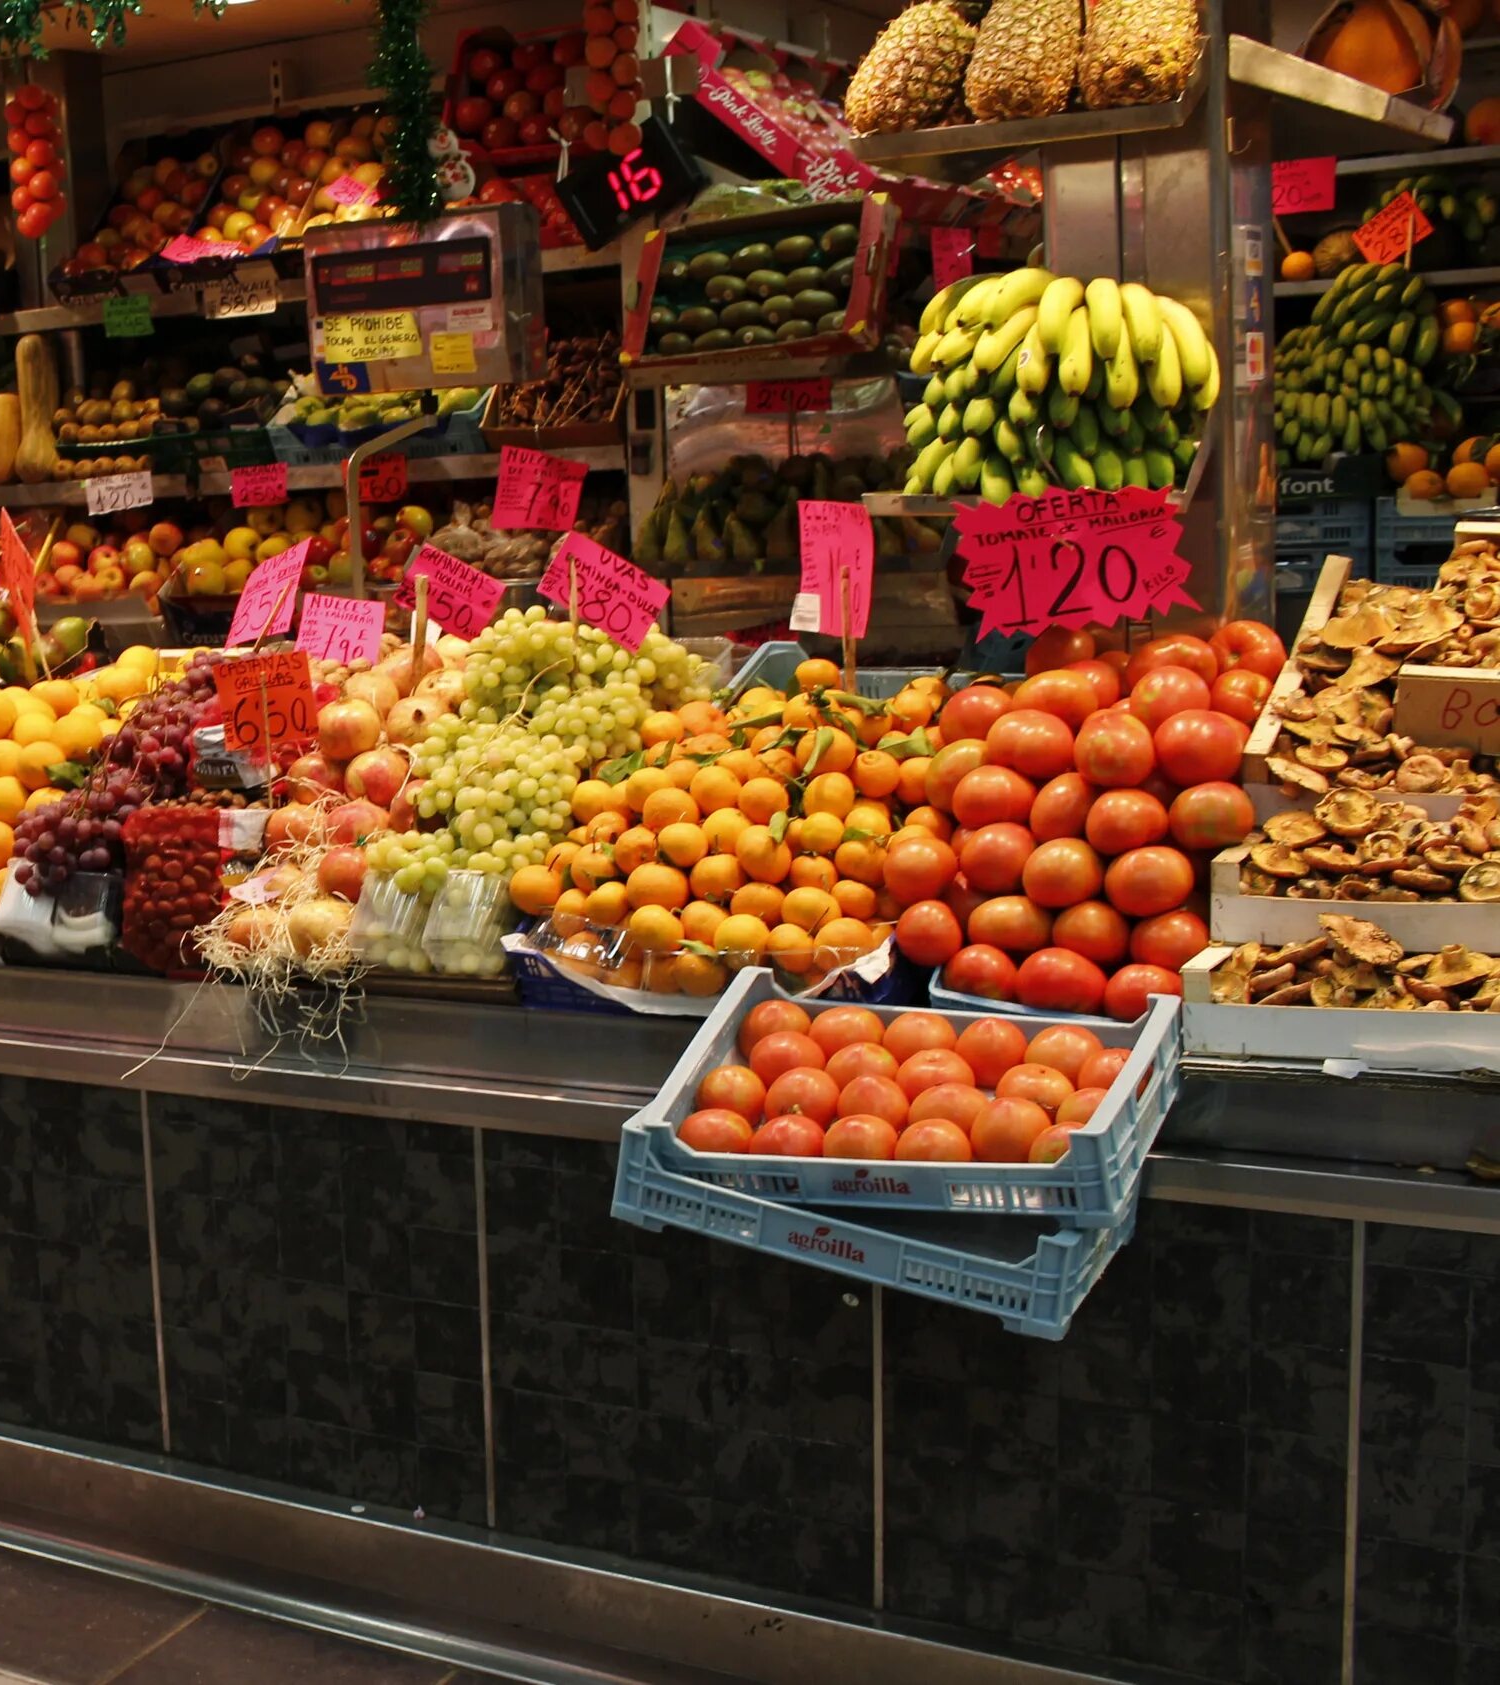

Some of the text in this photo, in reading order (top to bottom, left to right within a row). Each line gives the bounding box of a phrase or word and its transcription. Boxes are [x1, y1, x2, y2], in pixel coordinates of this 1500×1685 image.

[704, 83, 779, 155] Pink Lady
[607, 147, 662, 211] 16
[325, 315, 342, 331] SE
[364, 334, 377, 344] EL
[1280, 477, 1334, 495] font
[974, 506, 1167, 547] TOMATE de MALLORCA
[263, 549, 297, 575] UVAS
[600, 550, 650, 591] UVAS
[1000, 540, 1138, 627] 1'20
[1141, 565, 1176, 594] KILO
[234, 697, 307, 746] 6'50
[831, 1176, 912, 1196] agroilla
[787, 1230, 865, 1264] agroilla
